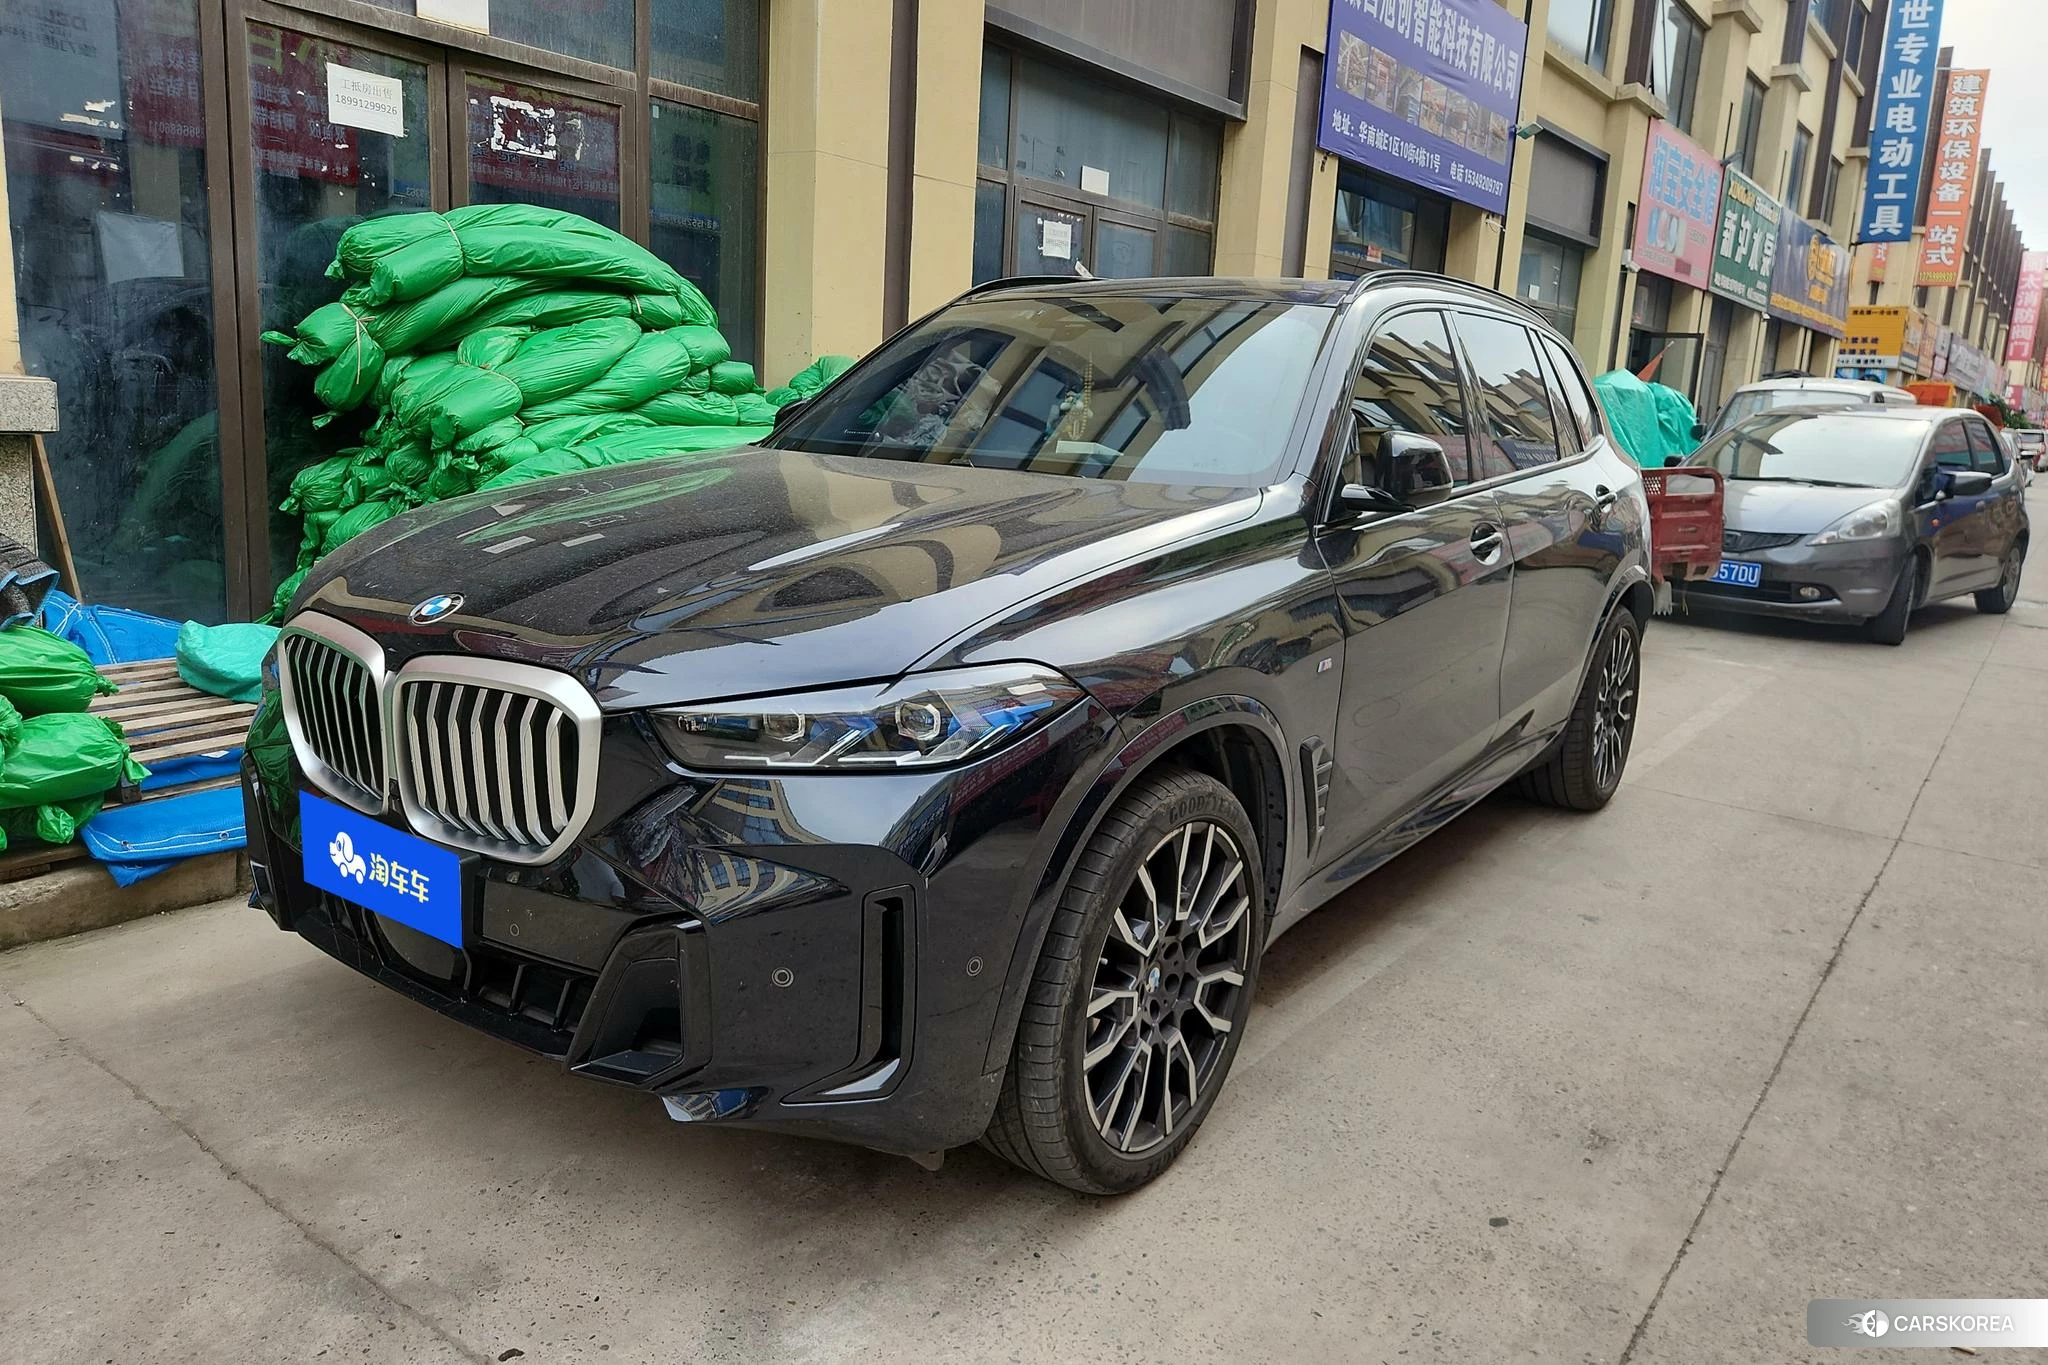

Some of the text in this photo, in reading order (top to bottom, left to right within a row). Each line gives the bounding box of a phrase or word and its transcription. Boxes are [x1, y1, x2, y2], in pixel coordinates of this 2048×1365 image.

[1345, 0, 1519, 100] 旭创智能科技有限公司
[335, 93, 398, 116] 18991299926
[1868, 0, 1934, 237] 世专业电动工具
[1925, 74, 1984, 267] 建筑环保设备一站式
[1713, 563, 1759, 583] 57DU
